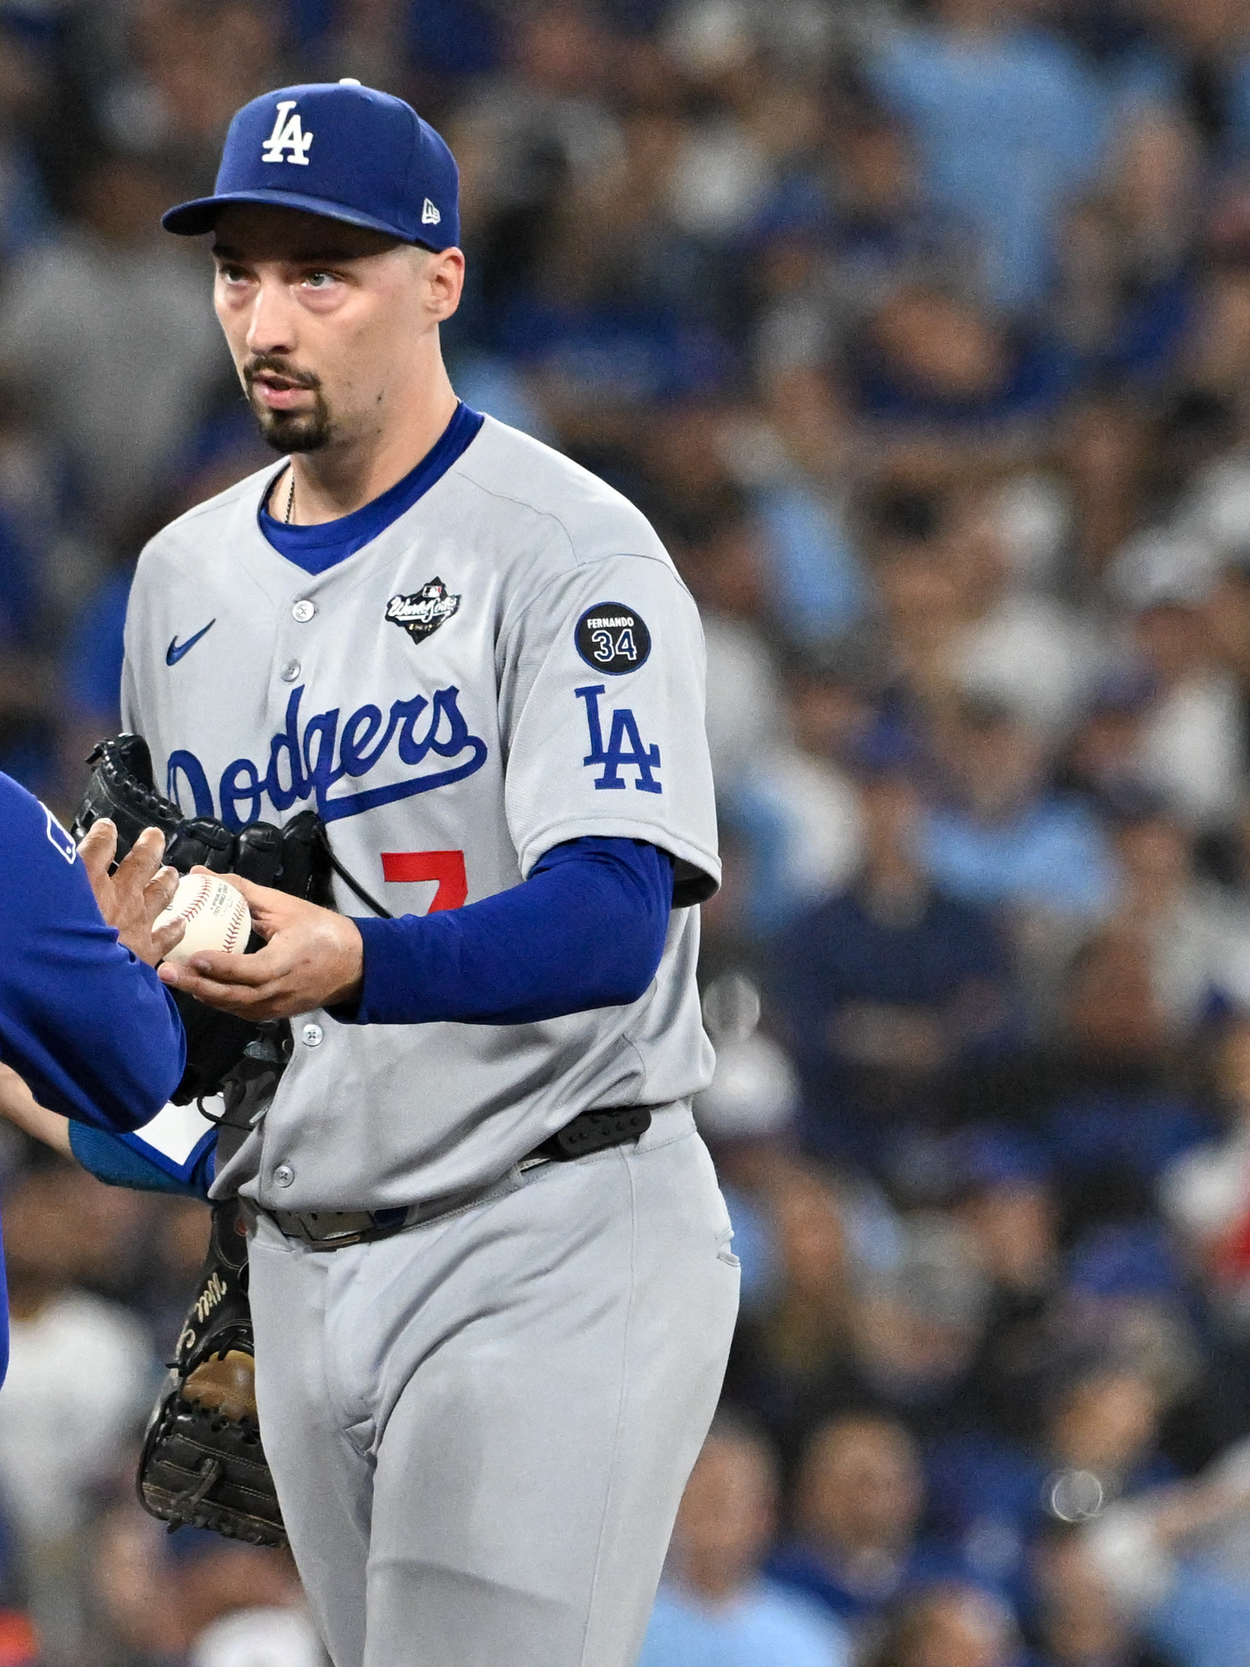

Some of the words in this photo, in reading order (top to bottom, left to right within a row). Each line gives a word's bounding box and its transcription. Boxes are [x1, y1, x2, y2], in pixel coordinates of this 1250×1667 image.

[262, 101, 313, 165] LA
[587, 616, 634, 629] FERNANDO
[591, 629, 637, 662] 34
[167, 684, 487, 833] Dodgers
[574, 684, 662, 794] LA
[381, 850, 467, 914] 7
